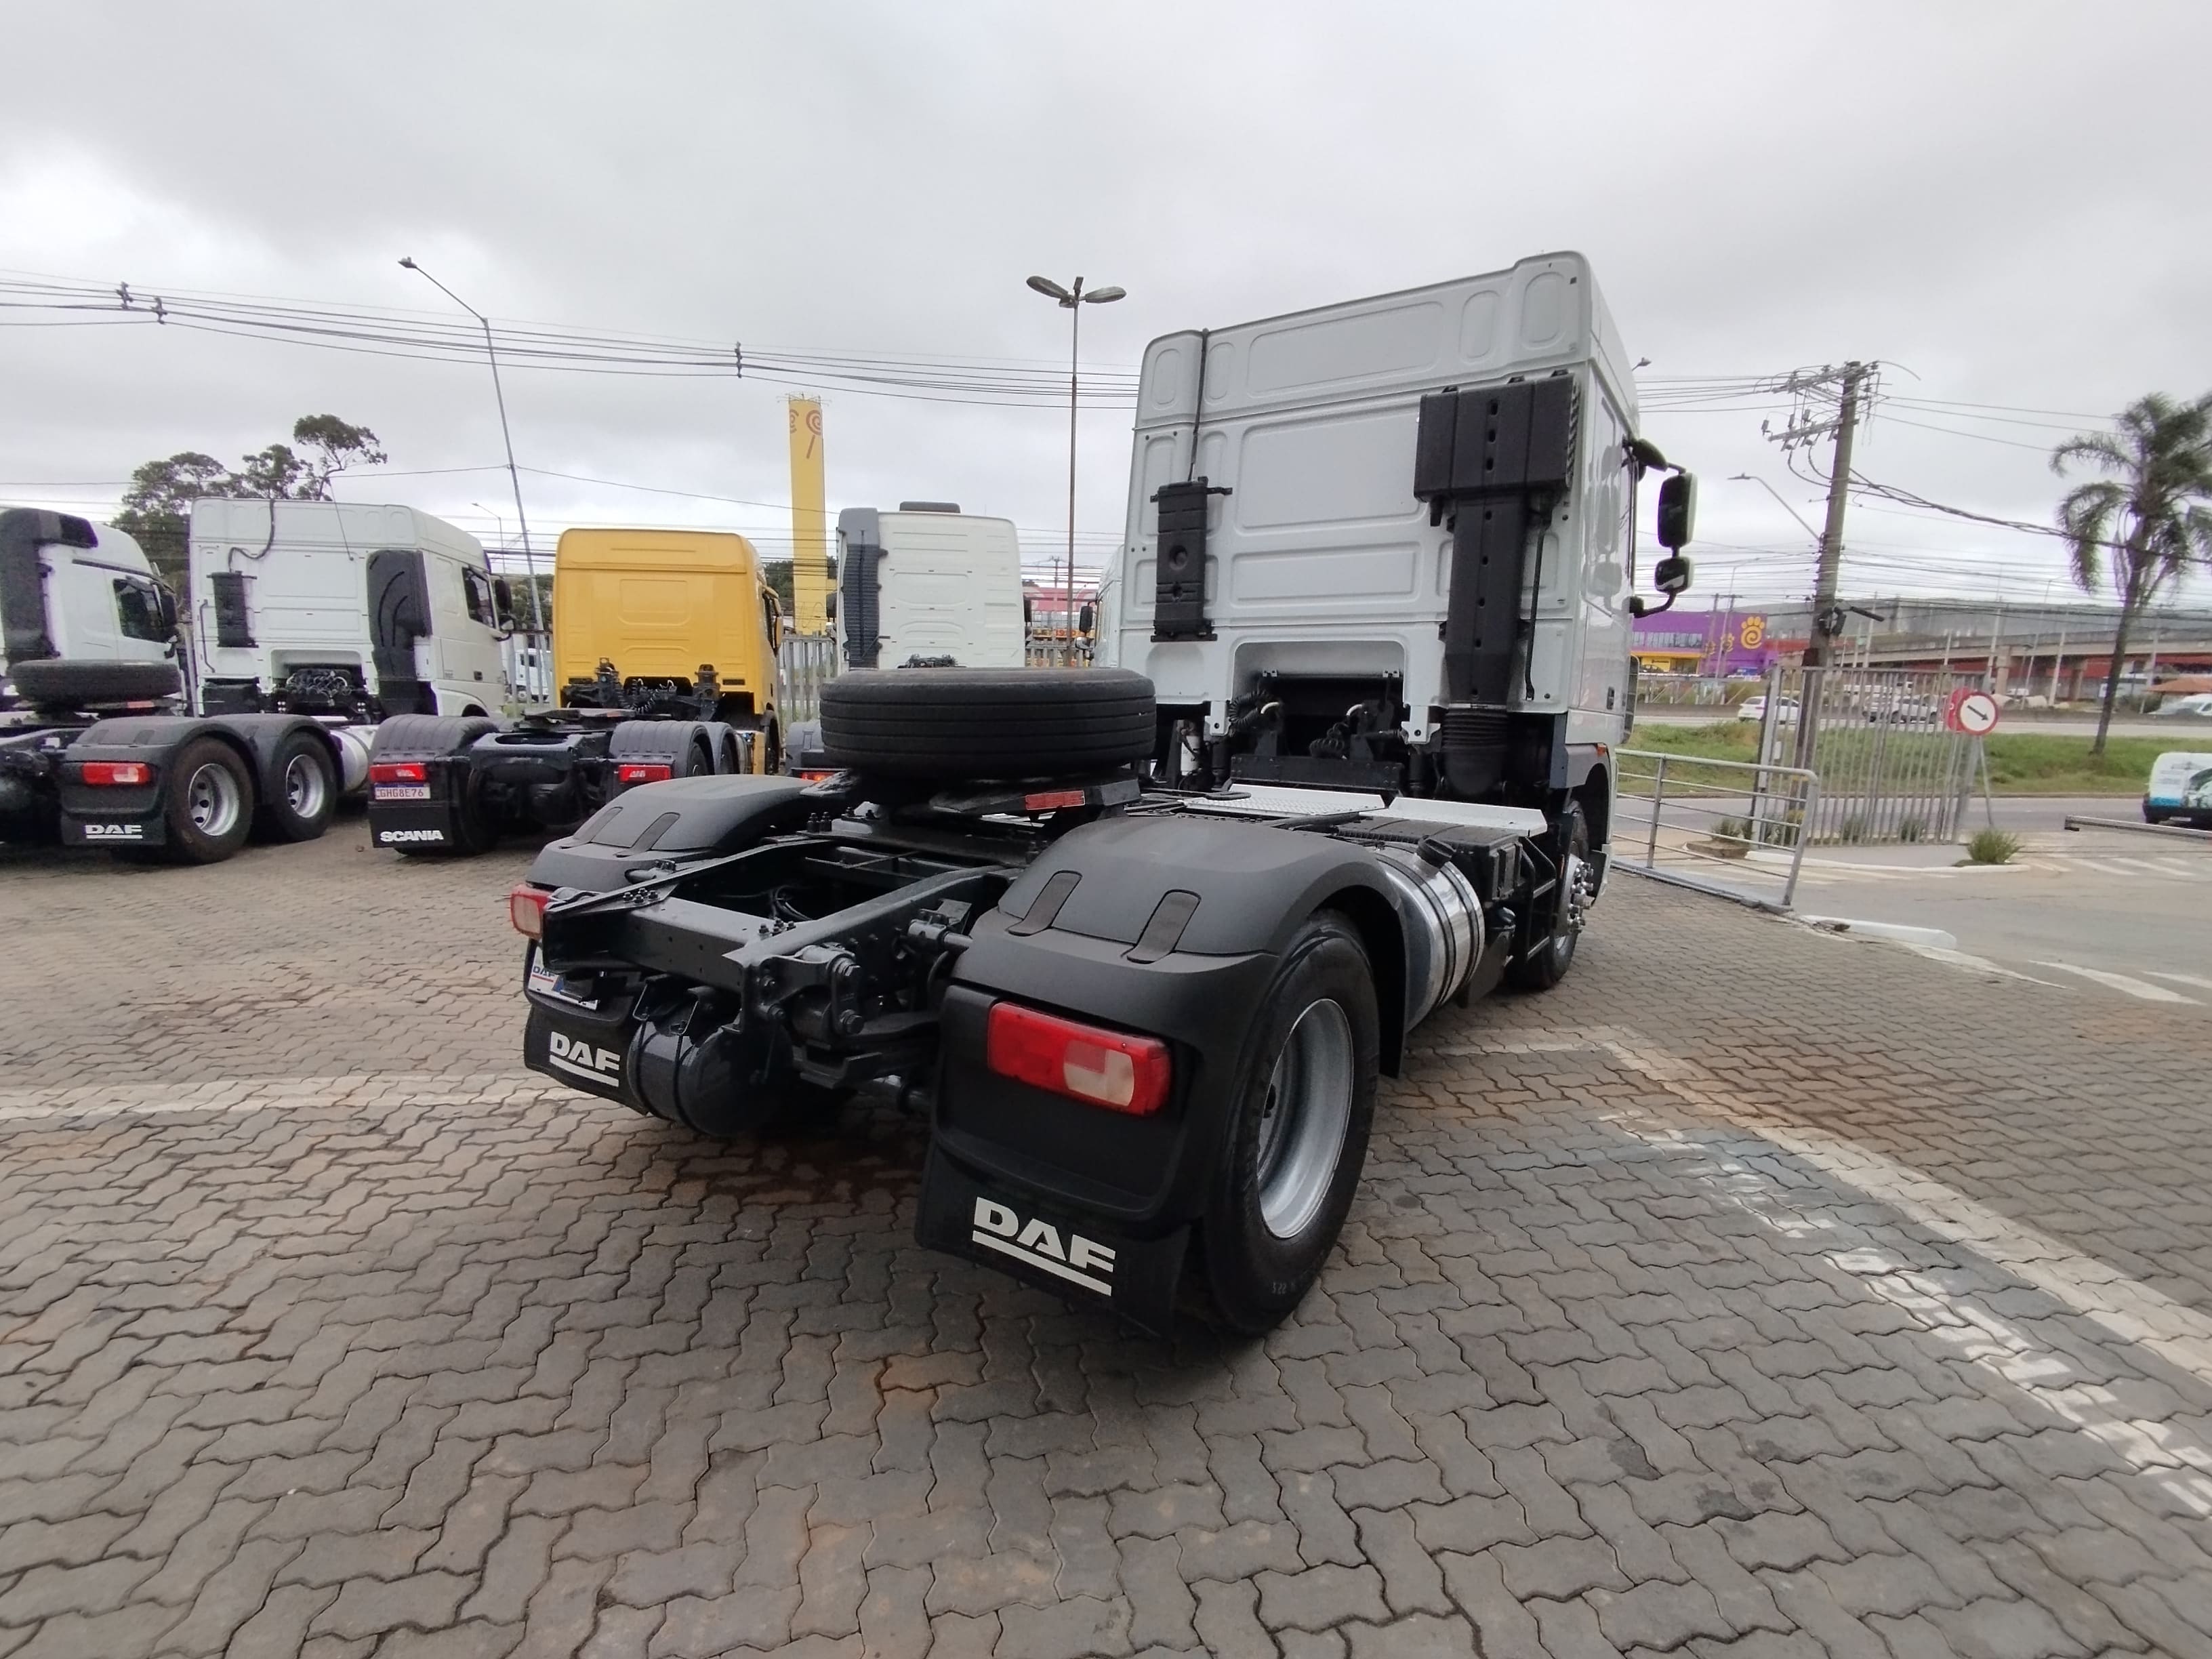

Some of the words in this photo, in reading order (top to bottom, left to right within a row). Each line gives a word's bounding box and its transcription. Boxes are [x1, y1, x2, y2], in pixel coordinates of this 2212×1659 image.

[85, 825, 142, 834] DAF
[380, 830, 445, 842] SCANIA
[550, 1031, 621, 1071] DAF
[974, 1196, 1116, 1273] DAF
